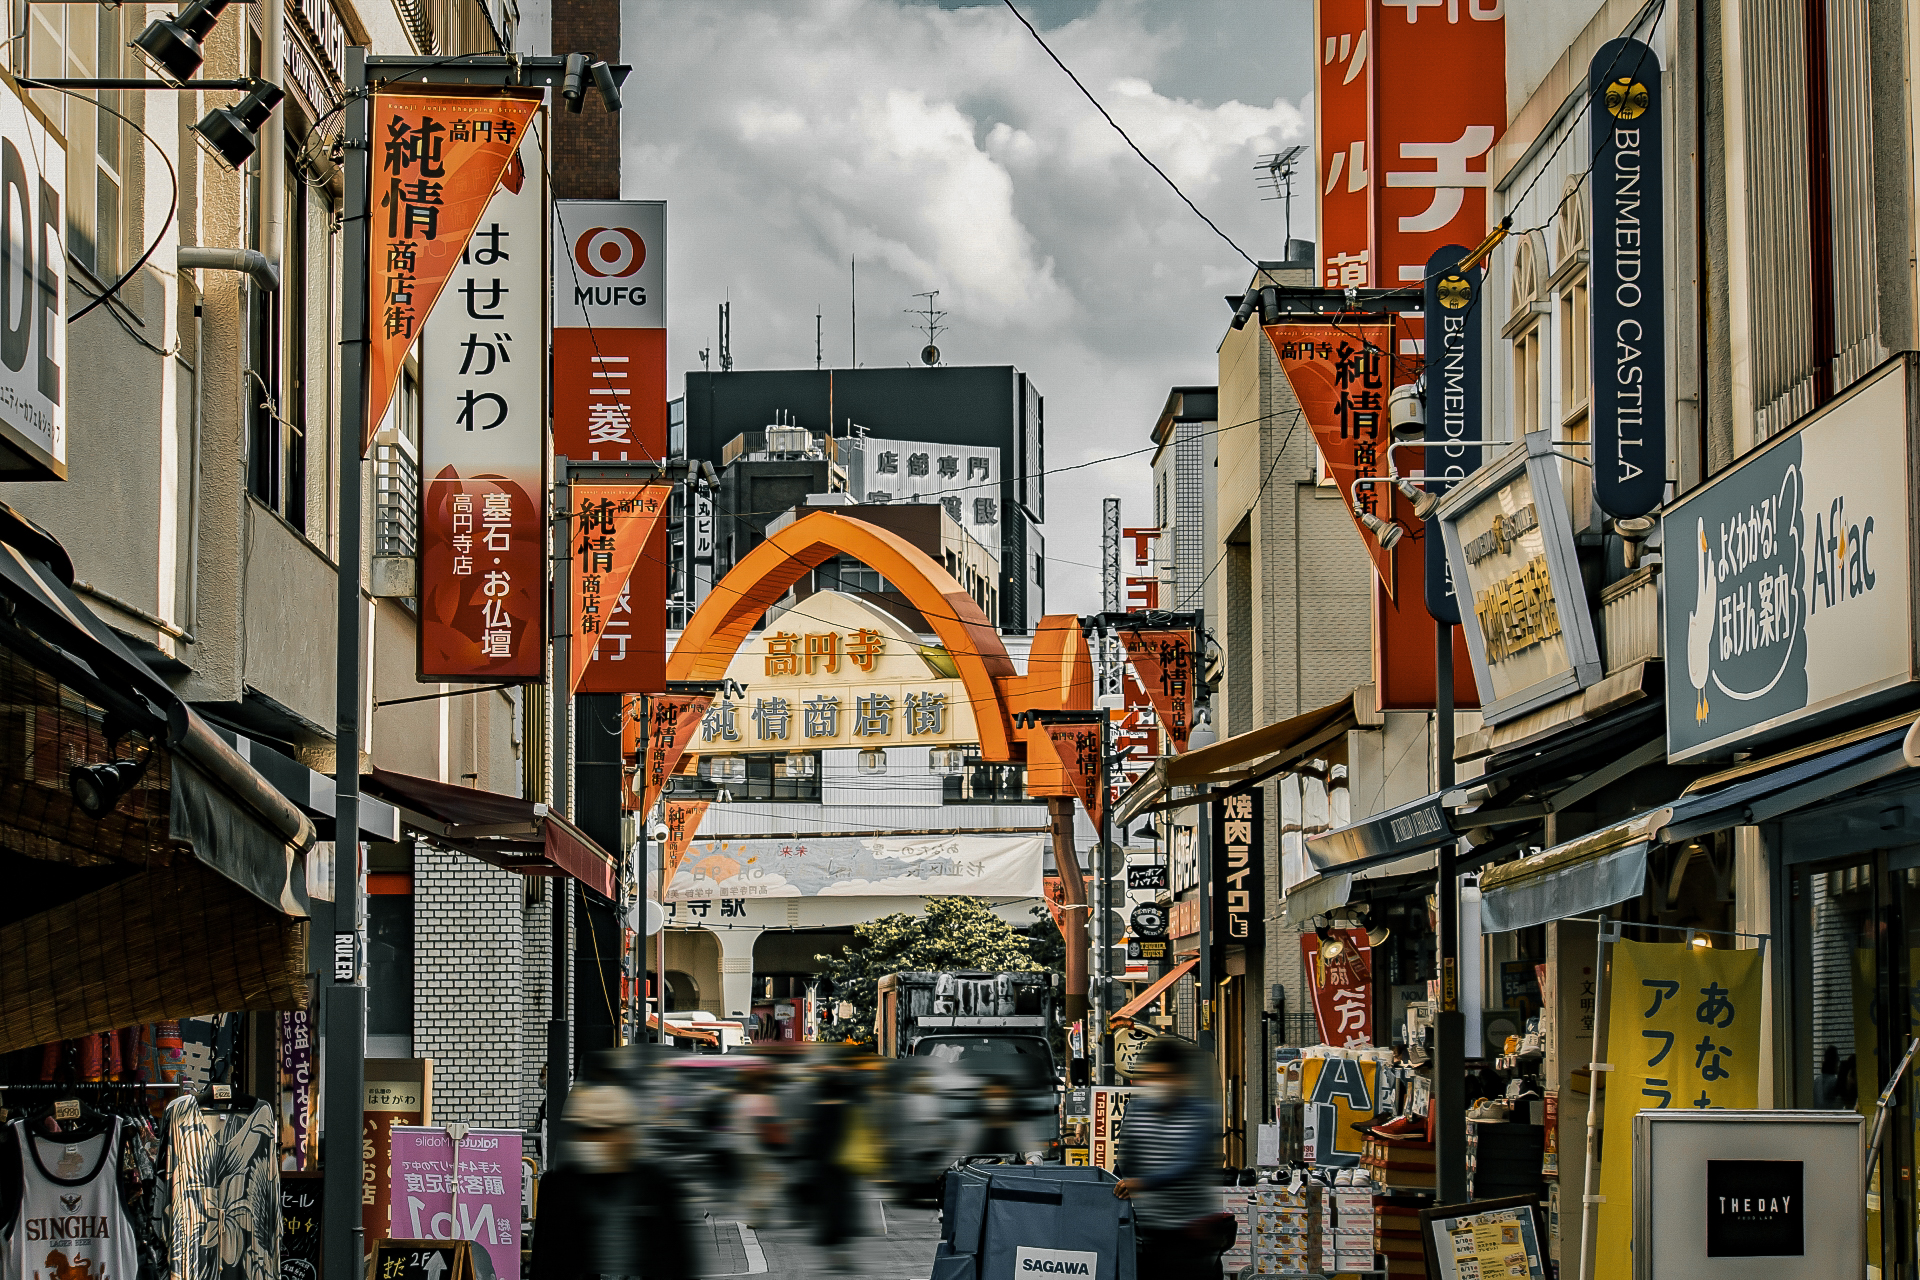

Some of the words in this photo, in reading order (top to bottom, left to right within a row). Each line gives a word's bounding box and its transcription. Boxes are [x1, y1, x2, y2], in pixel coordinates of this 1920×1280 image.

[423, 104, 447, 112] Junjo
[452, 105, 493, 113] Shopping
[449, 119, 516, 144] 高円寺
[1615, 128, 1642, 307] BUNMEIDO
[574, 286, 647, 306] MUFG
[456, 223, 513, 432] はせがわ
[1282, 341, 1332, 360] 高円寺
[588, 356, 632, 461] 三菱
[1443, 317, 1464, 458] BUNMEIDO
[1616, 320, 1644, 484] CASTILLA
[617, 498, 658, 513] 高円寺
[452, 493, 473, 576] 高円寺店
[1718, 495, 1777, 583] よくわかる!
[1811, 496, 1876, 616] Aflac
[481, 492, 512, 658] 墓石・お仏壇
[1719, 564, 1790, 662] ほけん案内
[763, 628, 886, 677] 高円寺
[702, 691, 947, 742] 純情商店街
[1224, 794, 1252, 912] 焼肉ライク
[335, 934, 353, 981] RULER
[368, 1095, 416, 1105] はせがわ
[1095, 1143, 1105, 1169] QUI
[25, 1216, 110, 1241] SINGHA
[1719, 1196, 1752, 1214] THE
[1758, 1195, 1791, 1214] DAY
[410, 1252, 431, 1267] 2F
[1022, 1258, 1090, 1276] SAGAWA
